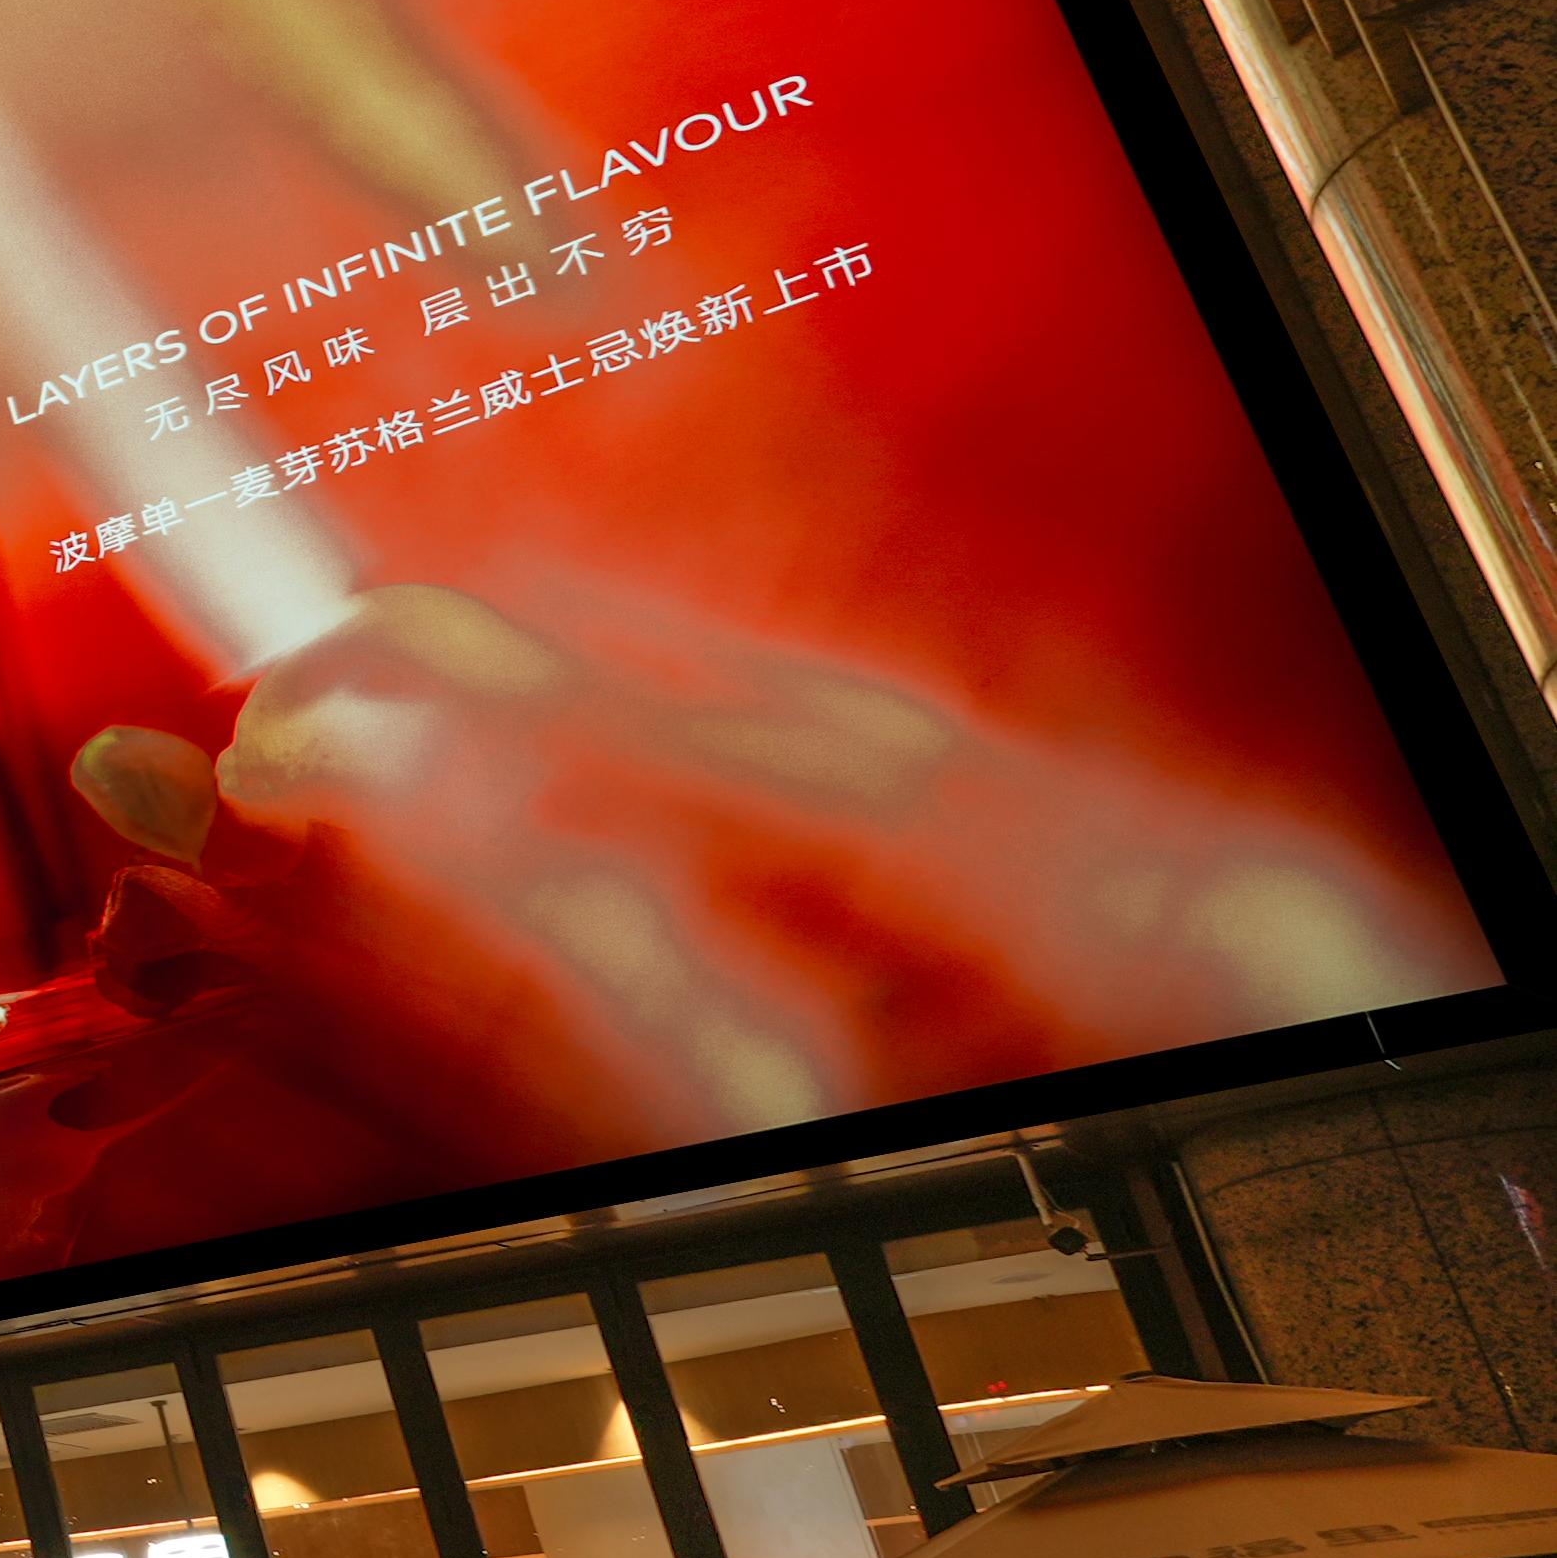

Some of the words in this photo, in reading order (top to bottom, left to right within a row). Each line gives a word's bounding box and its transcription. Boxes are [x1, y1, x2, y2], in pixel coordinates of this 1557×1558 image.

[7, 331, 188, 425] LAYERS
[199, 294, 269, 346] OF
[282, 197, 514, 315] INFINITE
[524, 75, 815, 216] FLAVOUR
[50, 242, 875, 575] 波摩单一麦芽苏格兰威士忌焕新上市
[143, 326, 376, 443] 无尽风味
[420, 206, 675, 337] 层出不穷
